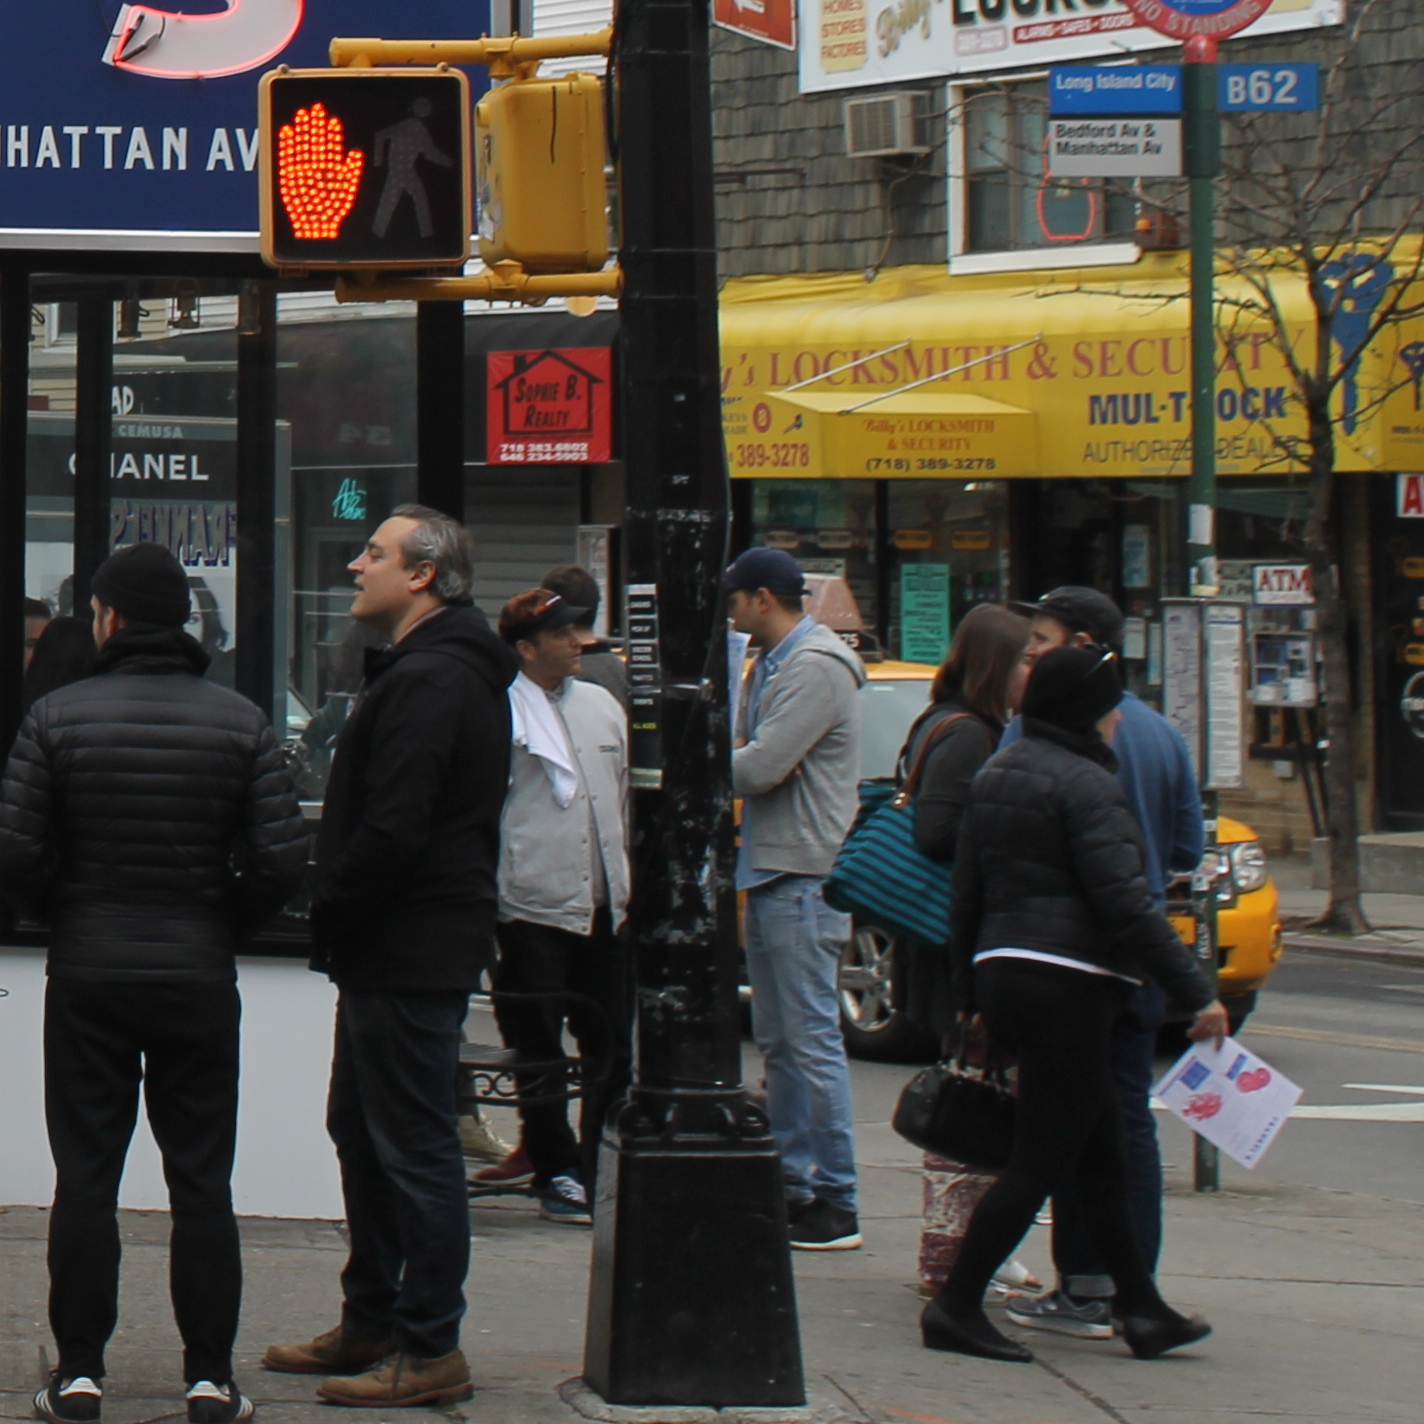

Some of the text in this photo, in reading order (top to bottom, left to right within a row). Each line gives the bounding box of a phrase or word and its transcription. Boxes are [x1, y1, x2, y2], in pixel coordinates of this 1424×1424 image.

[821, 18, 866, 39] STORES
[820, 40, 867, 60] FACTORIES
[1055, 73, 1176, 94] Long Island City
[1226, 69, 1299, 106] B62
[1055, 123, 1116, 139] Bedford
[1120, 123, 1139, 138] Av
[1055, 140, 1163, 156] Manhattan Av
[768, 344, 1012, 388] LOCKSMITH
[1026, 342, 1058, 380] &
[1072, 328, 1307, 379] SECUITY
[525, 404, 572, 428] REALTY
[907, 419, 996, 435] LOCKSMITH
[736, 443, 810, 469] 389-3278
[1082, 439, 1194, 464] AUTHORIZE
[67, 452, 210, 481] ANEL
[1256, 568, 1314, 593] ATM
